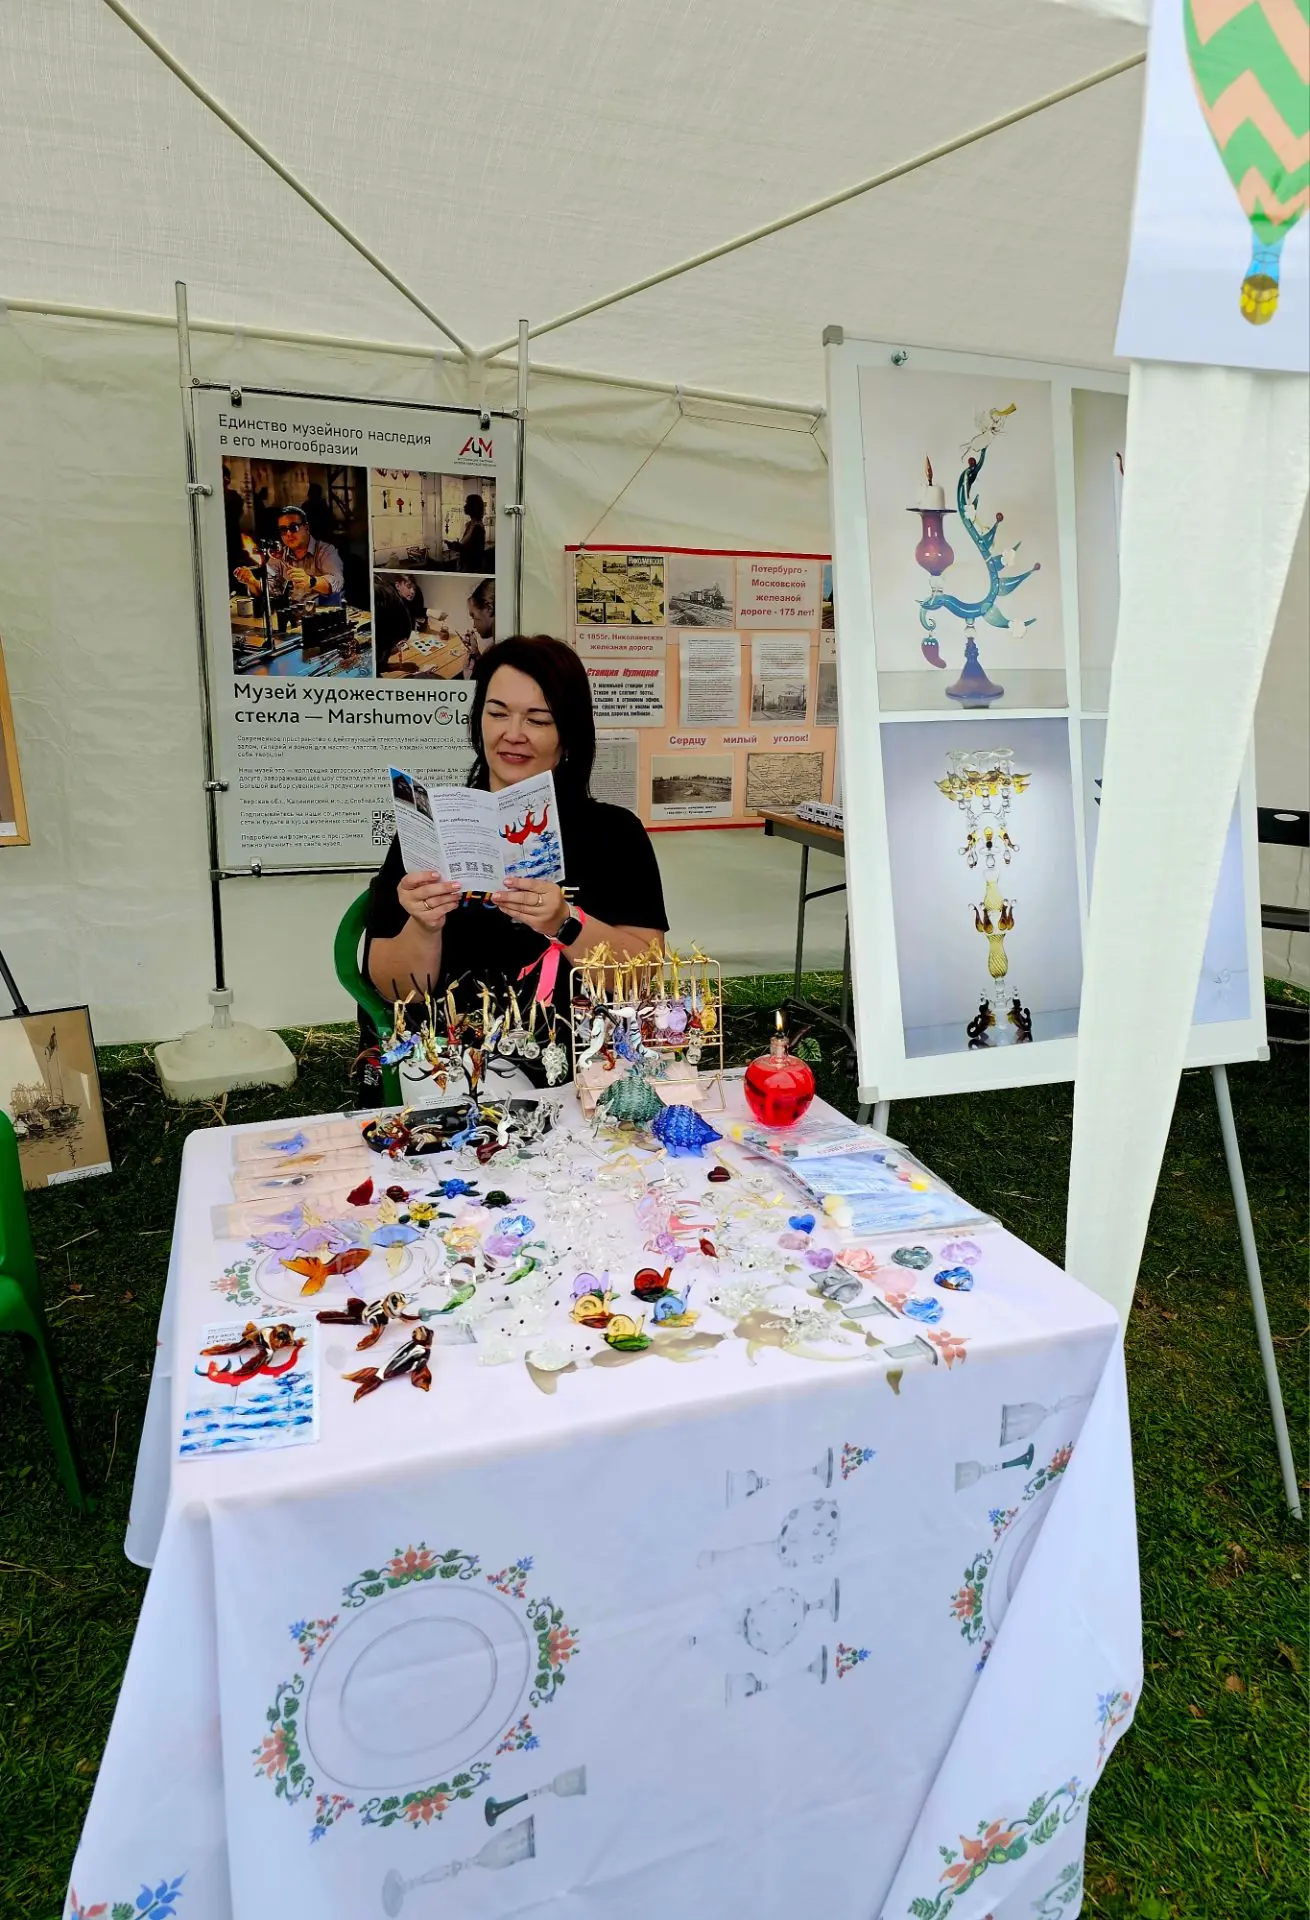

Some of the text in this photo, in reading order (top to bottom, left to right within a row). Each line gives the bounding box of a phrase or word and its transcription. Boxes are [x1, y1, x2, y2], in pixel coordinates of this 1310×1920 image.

[218, 414, 431, 446] Единство музейного наследия
[220, 435, 358, 456] в его многообразии
[751, 564, 802, 575] Петербурго
[751, 579, 806, 588] Московской
[756, 594, 801, 602] железной
[740, 608, 772, 616] дороге
[780, 608, 795, 616] 175
[234, 683, 467, 705] Музей художественного
[235, 709, 300, 723] стекла
[669, 734, 809, 746] Сердцу милый уголок!
